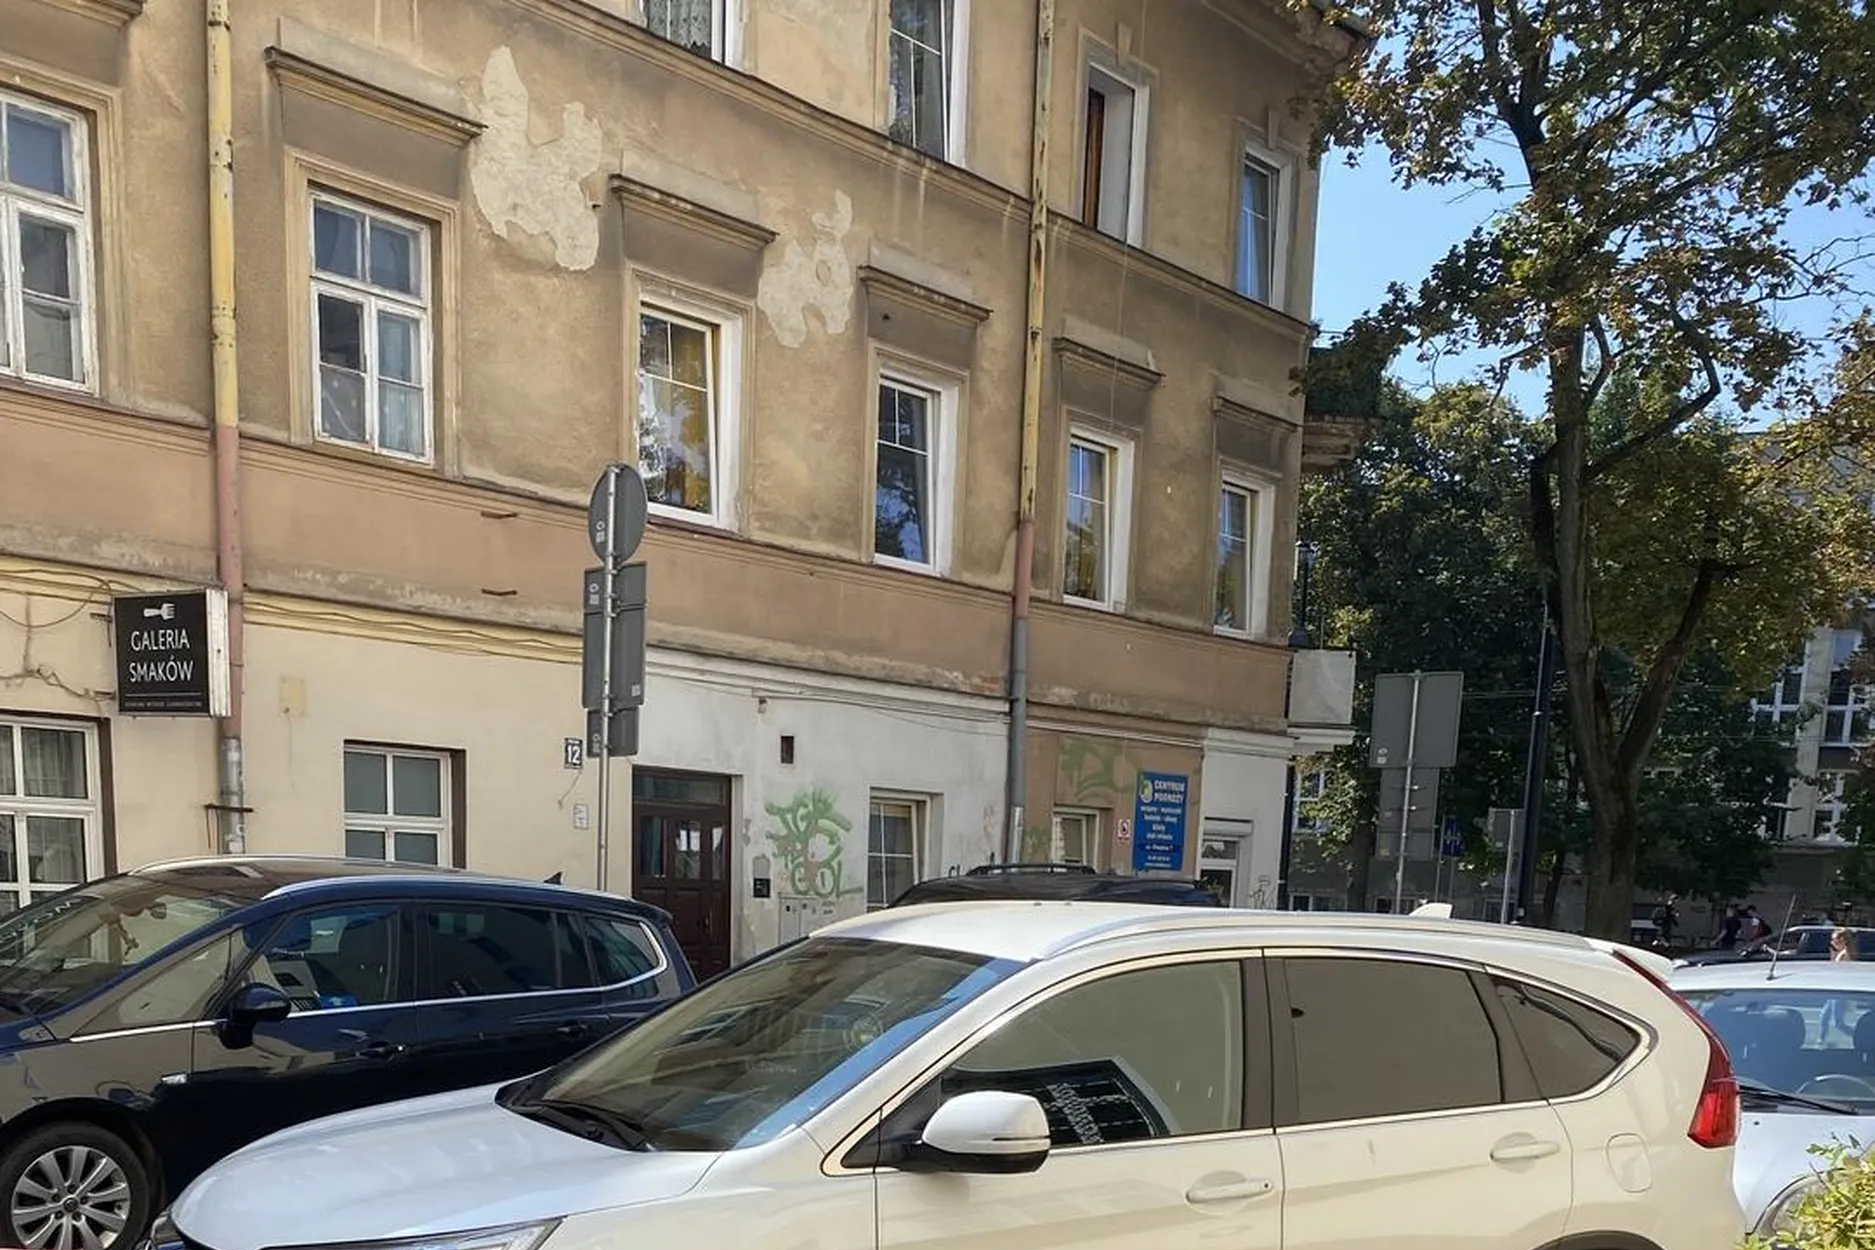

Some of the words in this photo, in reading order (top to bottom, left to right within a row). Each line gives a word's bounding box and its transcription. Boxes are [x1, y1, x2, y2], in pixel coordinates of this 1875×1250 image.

[131, 628, 190, 651] GALERIA
[128, 654, 194, 682] SMAKÓW
[567, 744, 581, 764] 12
